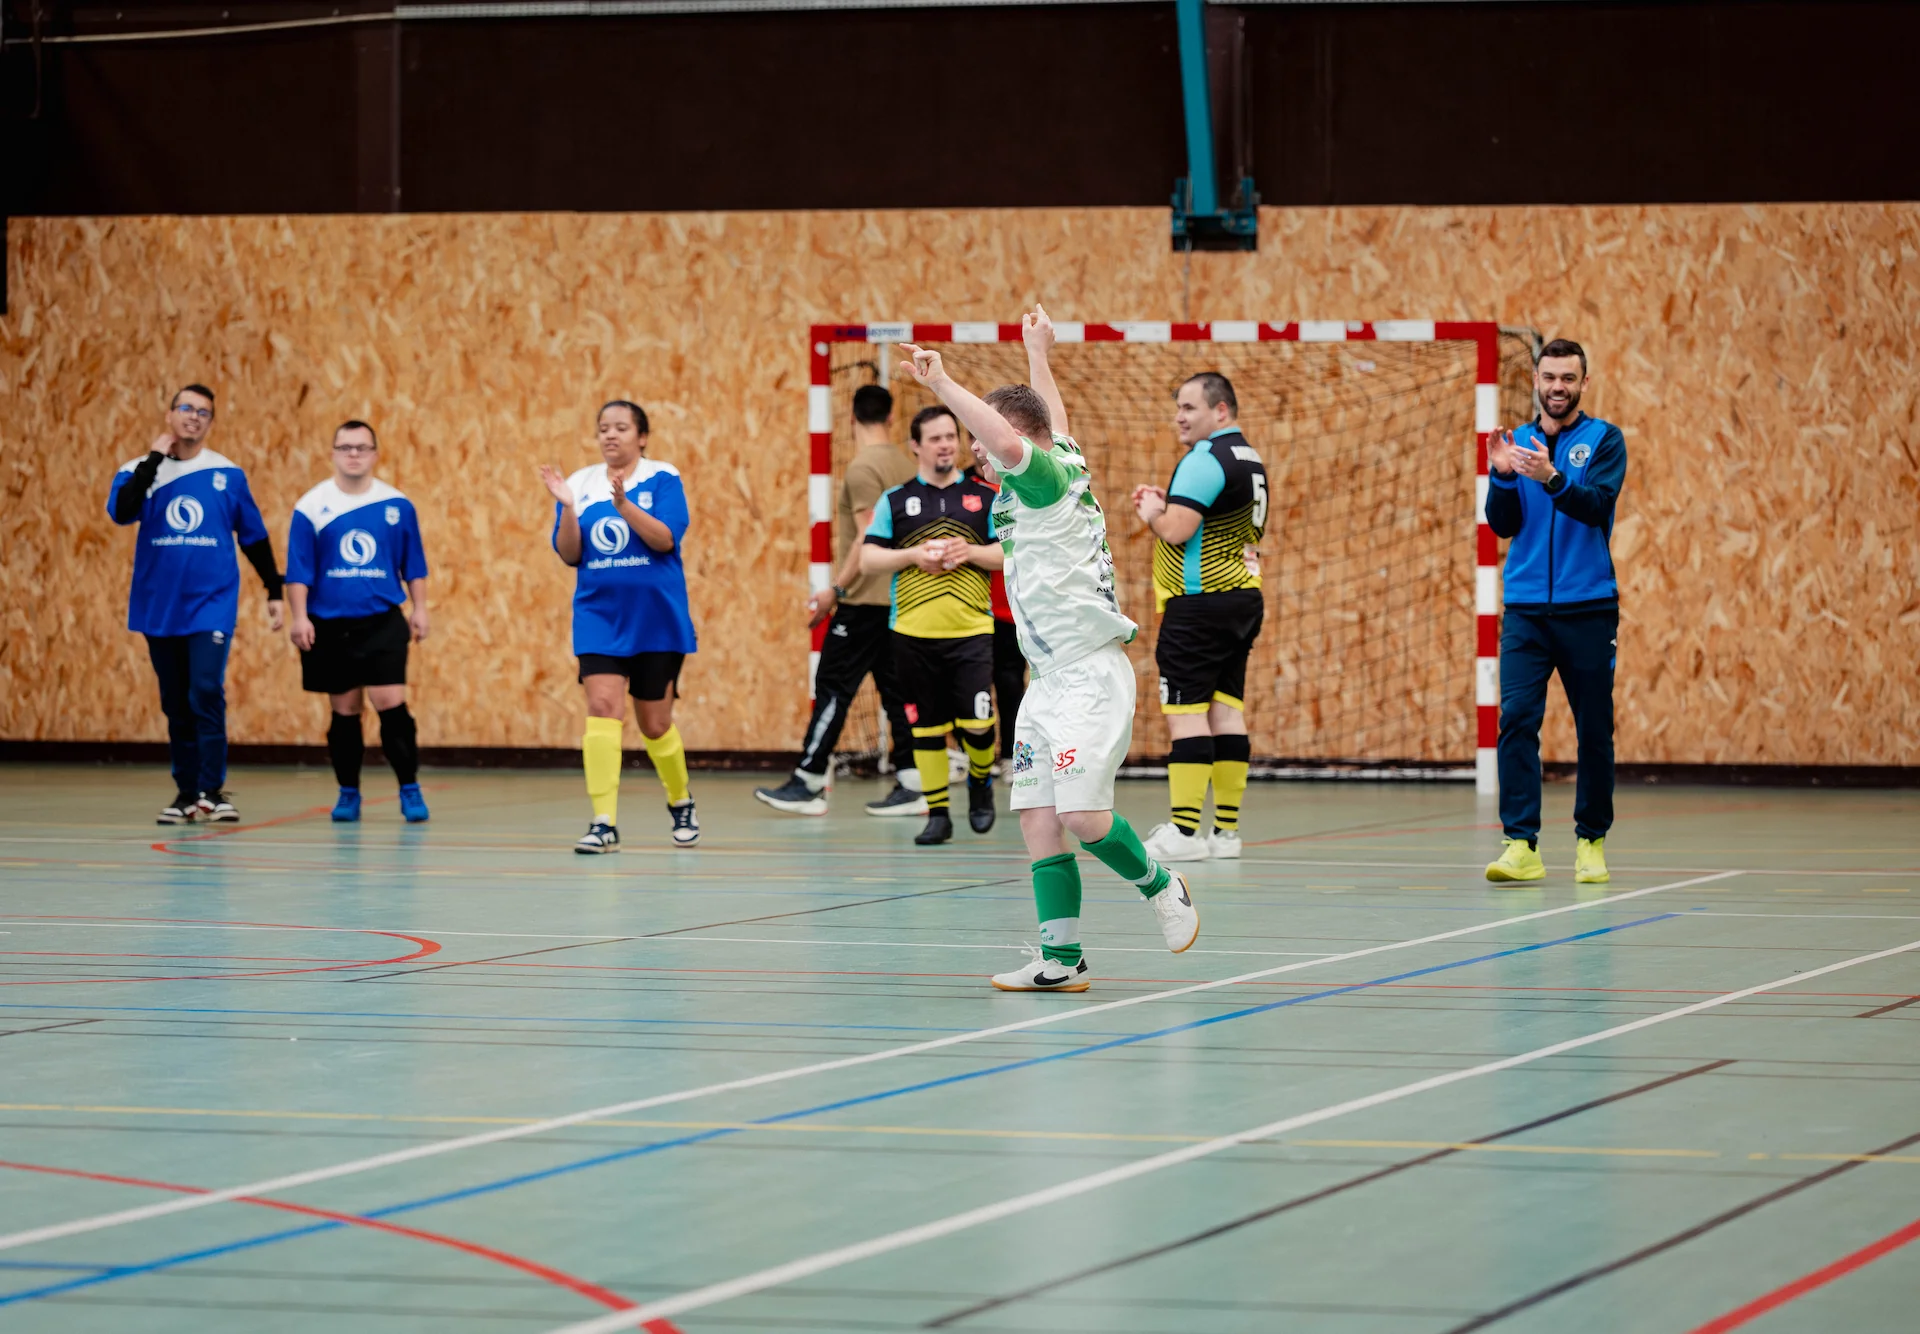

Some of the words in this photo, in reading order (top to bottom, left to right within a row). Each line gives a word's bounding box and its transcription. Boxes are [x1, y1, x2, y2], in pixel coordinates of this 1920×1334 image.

[905, 496, 921, 516] 6
[1251, 472, 1268, 528] 5
[974, 691, 990, 719] 6
